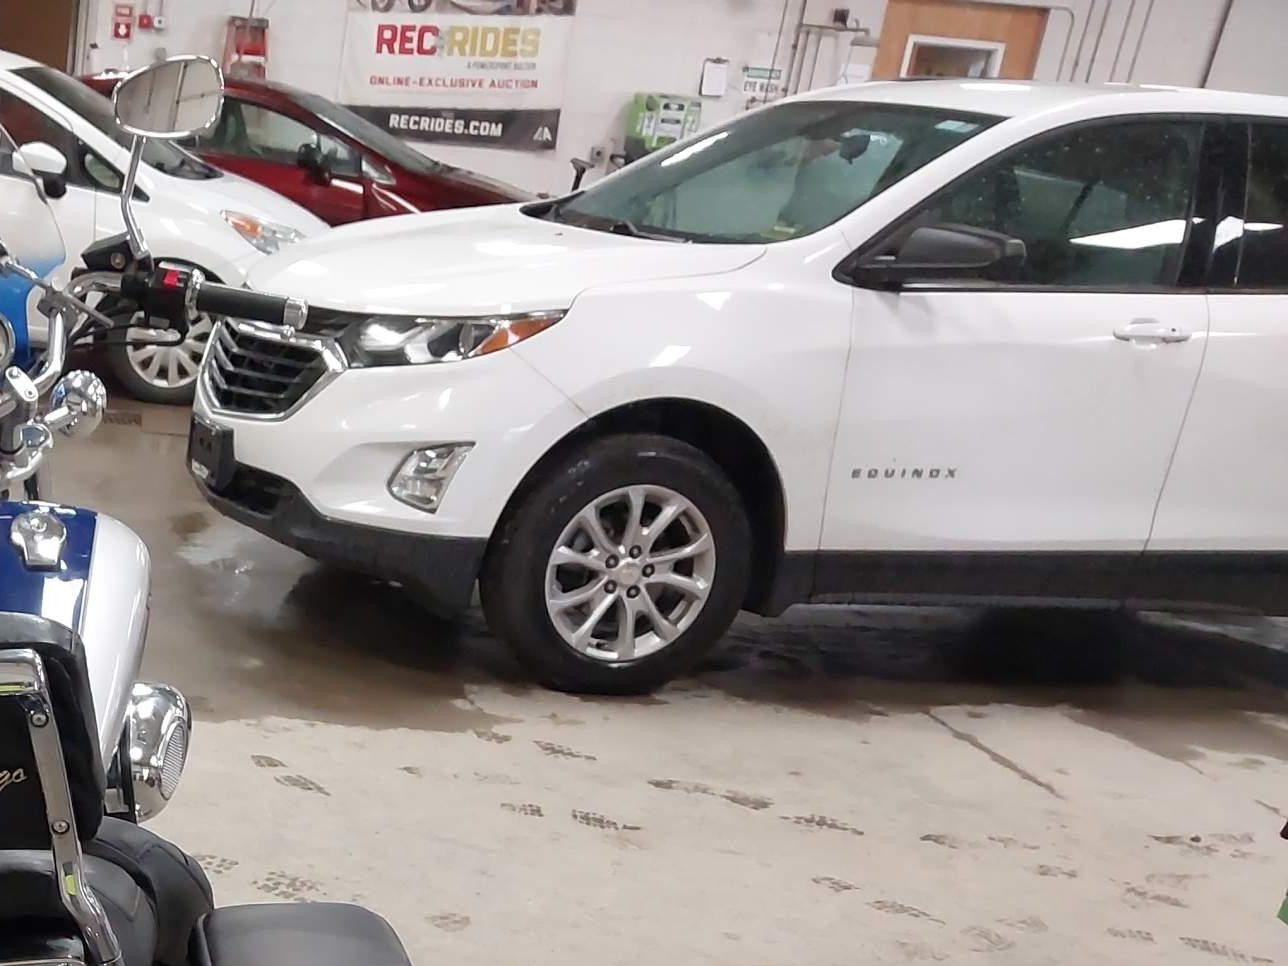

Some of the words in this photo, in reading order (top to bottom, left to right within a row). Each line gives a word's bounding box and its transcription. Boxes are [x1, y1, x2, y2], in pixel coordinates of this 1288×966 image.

[376, 24, 440, 56] REC
[446, 25, 542, 58] RIDES
[369, 75, 485, 89] ONLINE-EXCLUSIVE
[489, 78, 539, 89] AUCTION
[389, 113, 504, 137] RECRIDES.COM
[851, 468, 957, 479] EQUINOX
